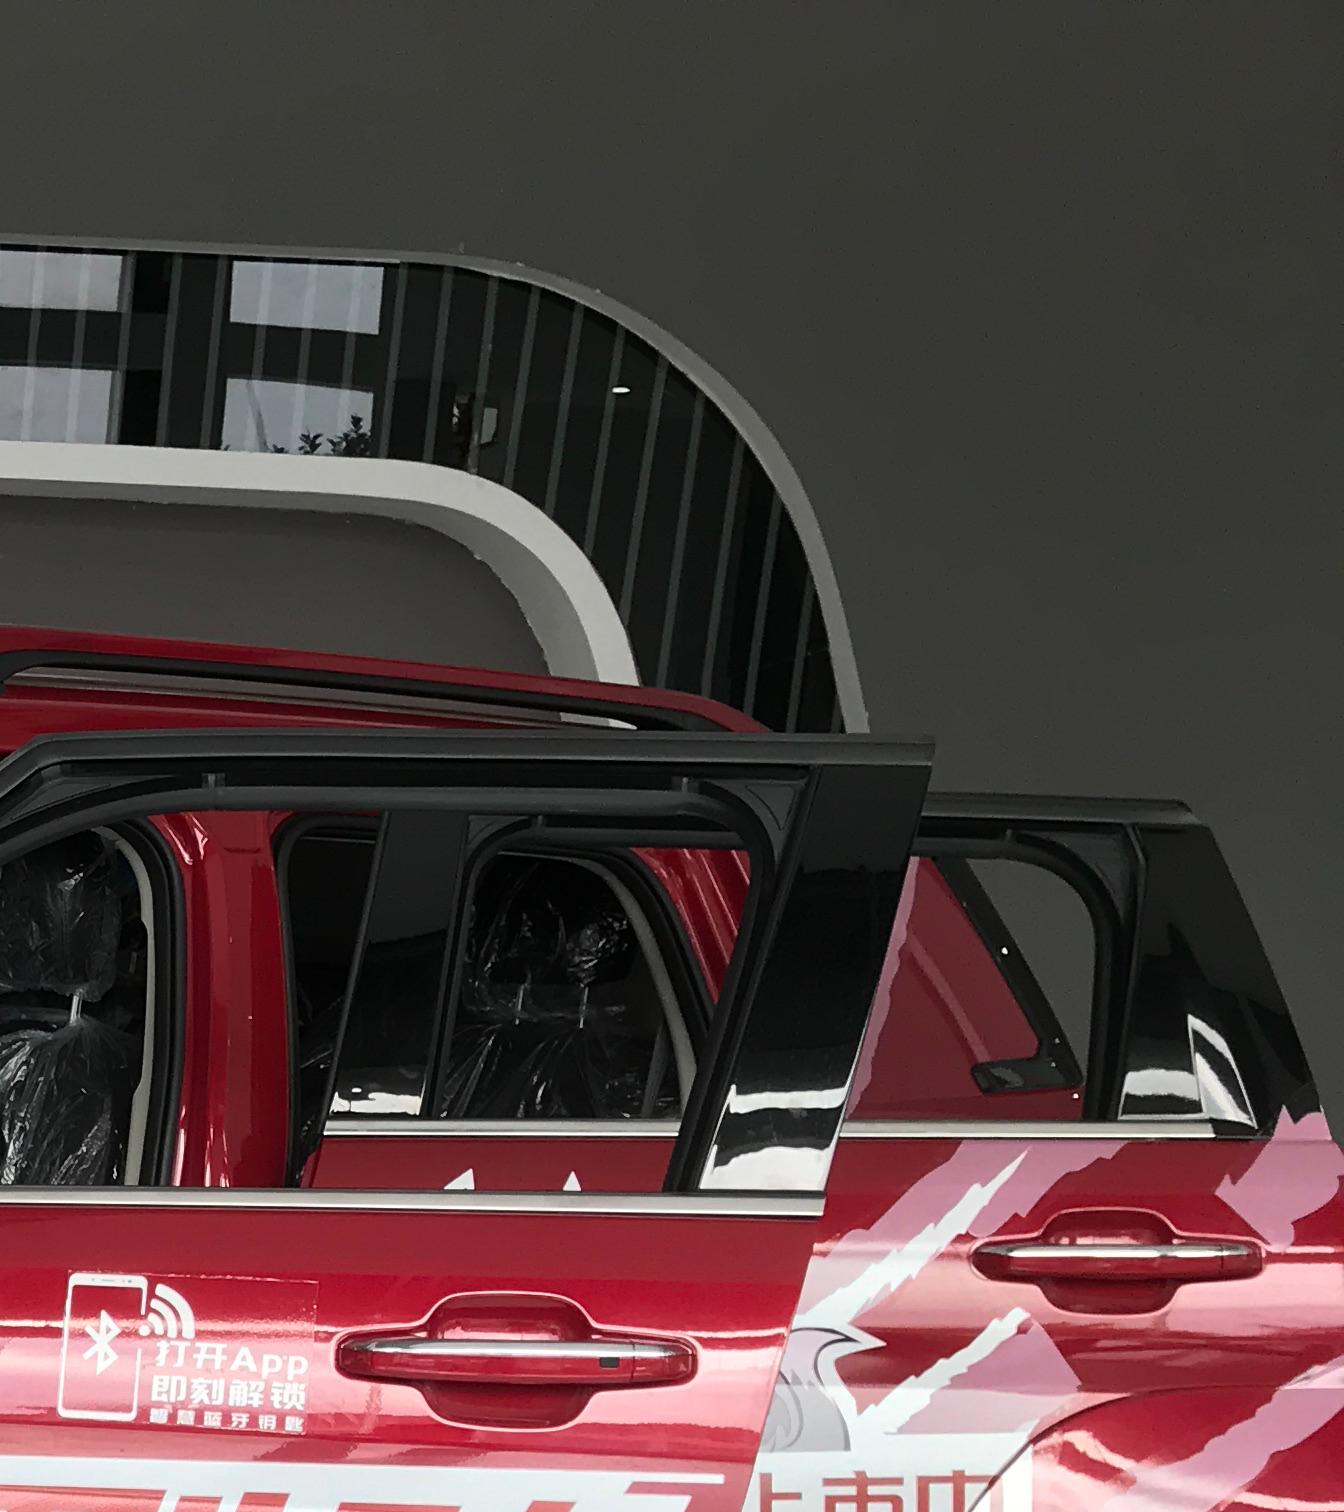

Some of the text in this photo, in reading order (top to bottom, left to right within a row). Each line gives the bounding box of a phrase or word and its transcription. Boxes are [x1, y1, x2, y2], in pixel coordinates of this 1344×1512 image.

[156, 1340, 309, 1382] 打开App
[150, 1375, 307, 1411] 即刻解锁
[149, 1407, 306, 1433] 智慧蓝牙钥匙
